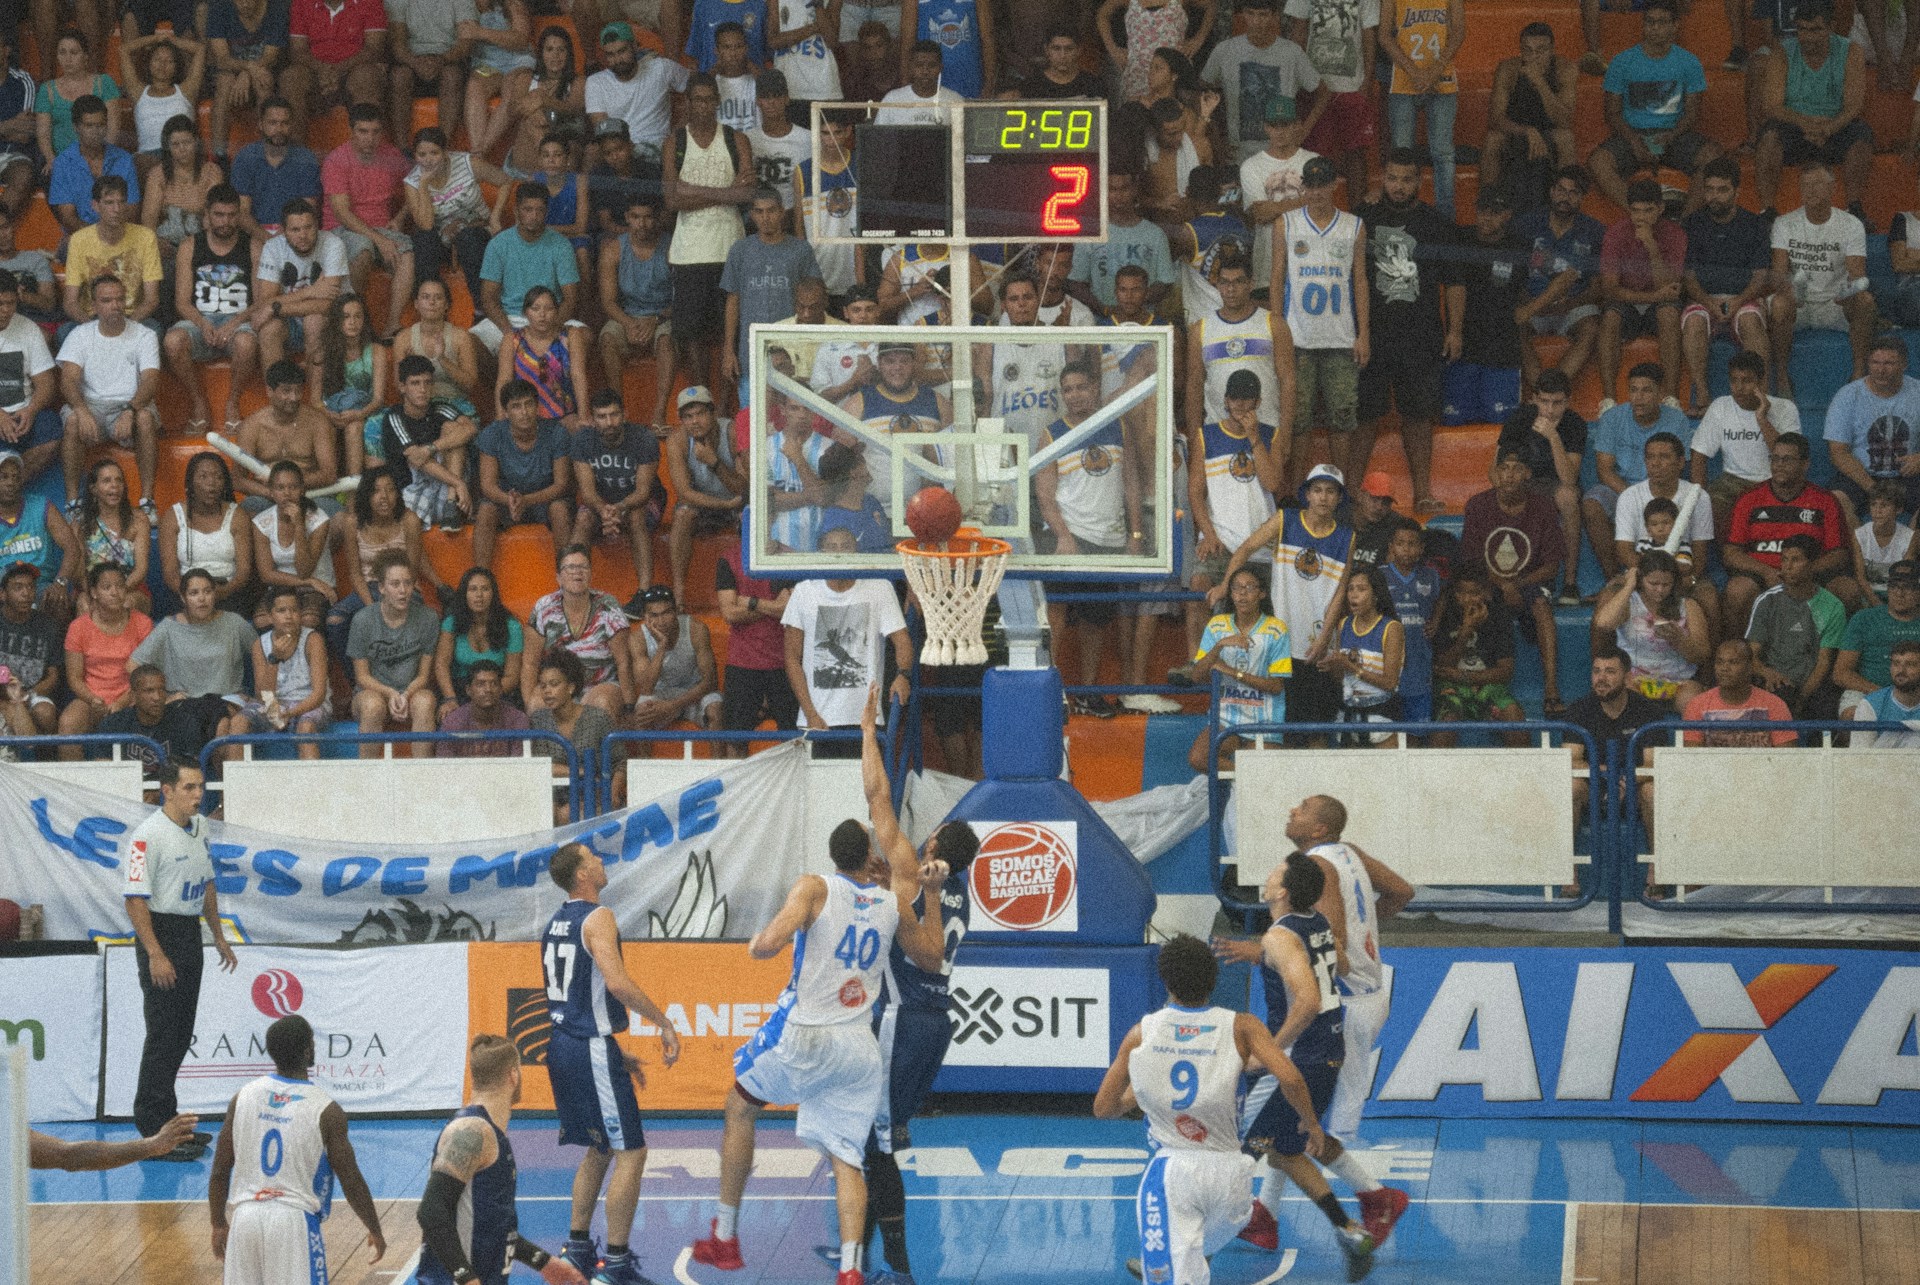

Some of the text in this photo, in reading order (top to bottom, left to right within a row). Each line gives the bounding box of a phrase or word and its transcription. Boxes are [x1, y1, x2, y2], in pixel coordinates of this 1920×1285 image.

[1402, 8, 1448, 28] LAKERS
[1409, 32, 1441, 60] 24
[1001, 110, 1092, 148] 2:58
[1043, 166, 1089, 233] 2
[1302, 282, 1341, 316] 01
[1723, 428, 1762, 442] Hurley
[1353, 549, 1379, 564] CAÉ
[30, 797, 302, 898] LEES
[322, 856, 430, 897] DE
[129, 841, 147, 881] SKY
[989, 853, 1055, 874] SOMOS
[989, 882, 1055, 899] BASQUETE
[834, 924, 880, 971] 40
[544, 942, 576, 1002] 17
[629, 1003, 778, 1037] LANE
[1011, 996, 1098, 1039] SIT
[1365, 962, 1920, 1106] AIXA
[188, 1032, 387, 1059] RAMDA
[316, 1064, 386, 1078] PLAZA
[1170, 1060, 1199, 1111] 9
[261, 1128, 283, 1177] 0
[1146, 1191, 1161, 1226] SIT
